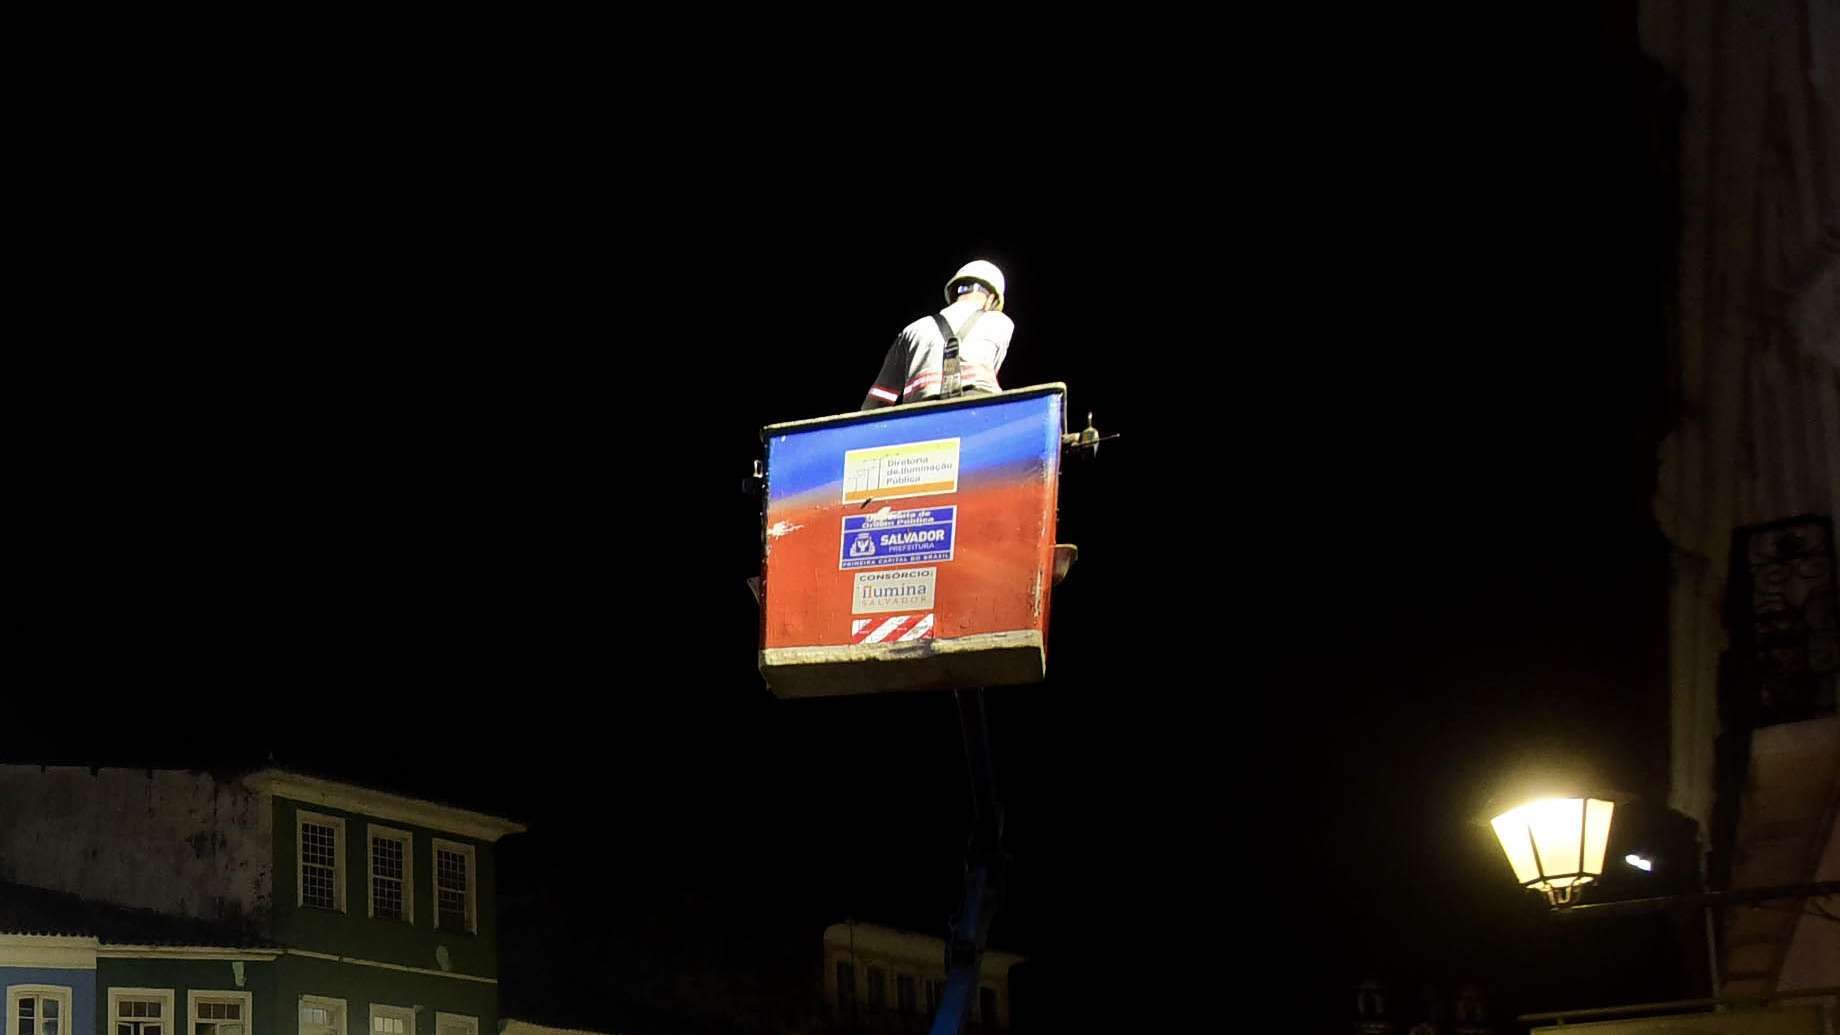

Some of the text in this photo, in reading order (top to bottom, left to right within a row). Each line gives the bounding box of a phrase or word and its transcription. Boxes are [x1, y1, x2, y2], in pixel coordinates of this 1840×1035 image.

[880, 529, 945, 546] SALVADOR
[888, 543, 935, 554] PREFEITURA
[862, 583, 927, 599] ilumina
